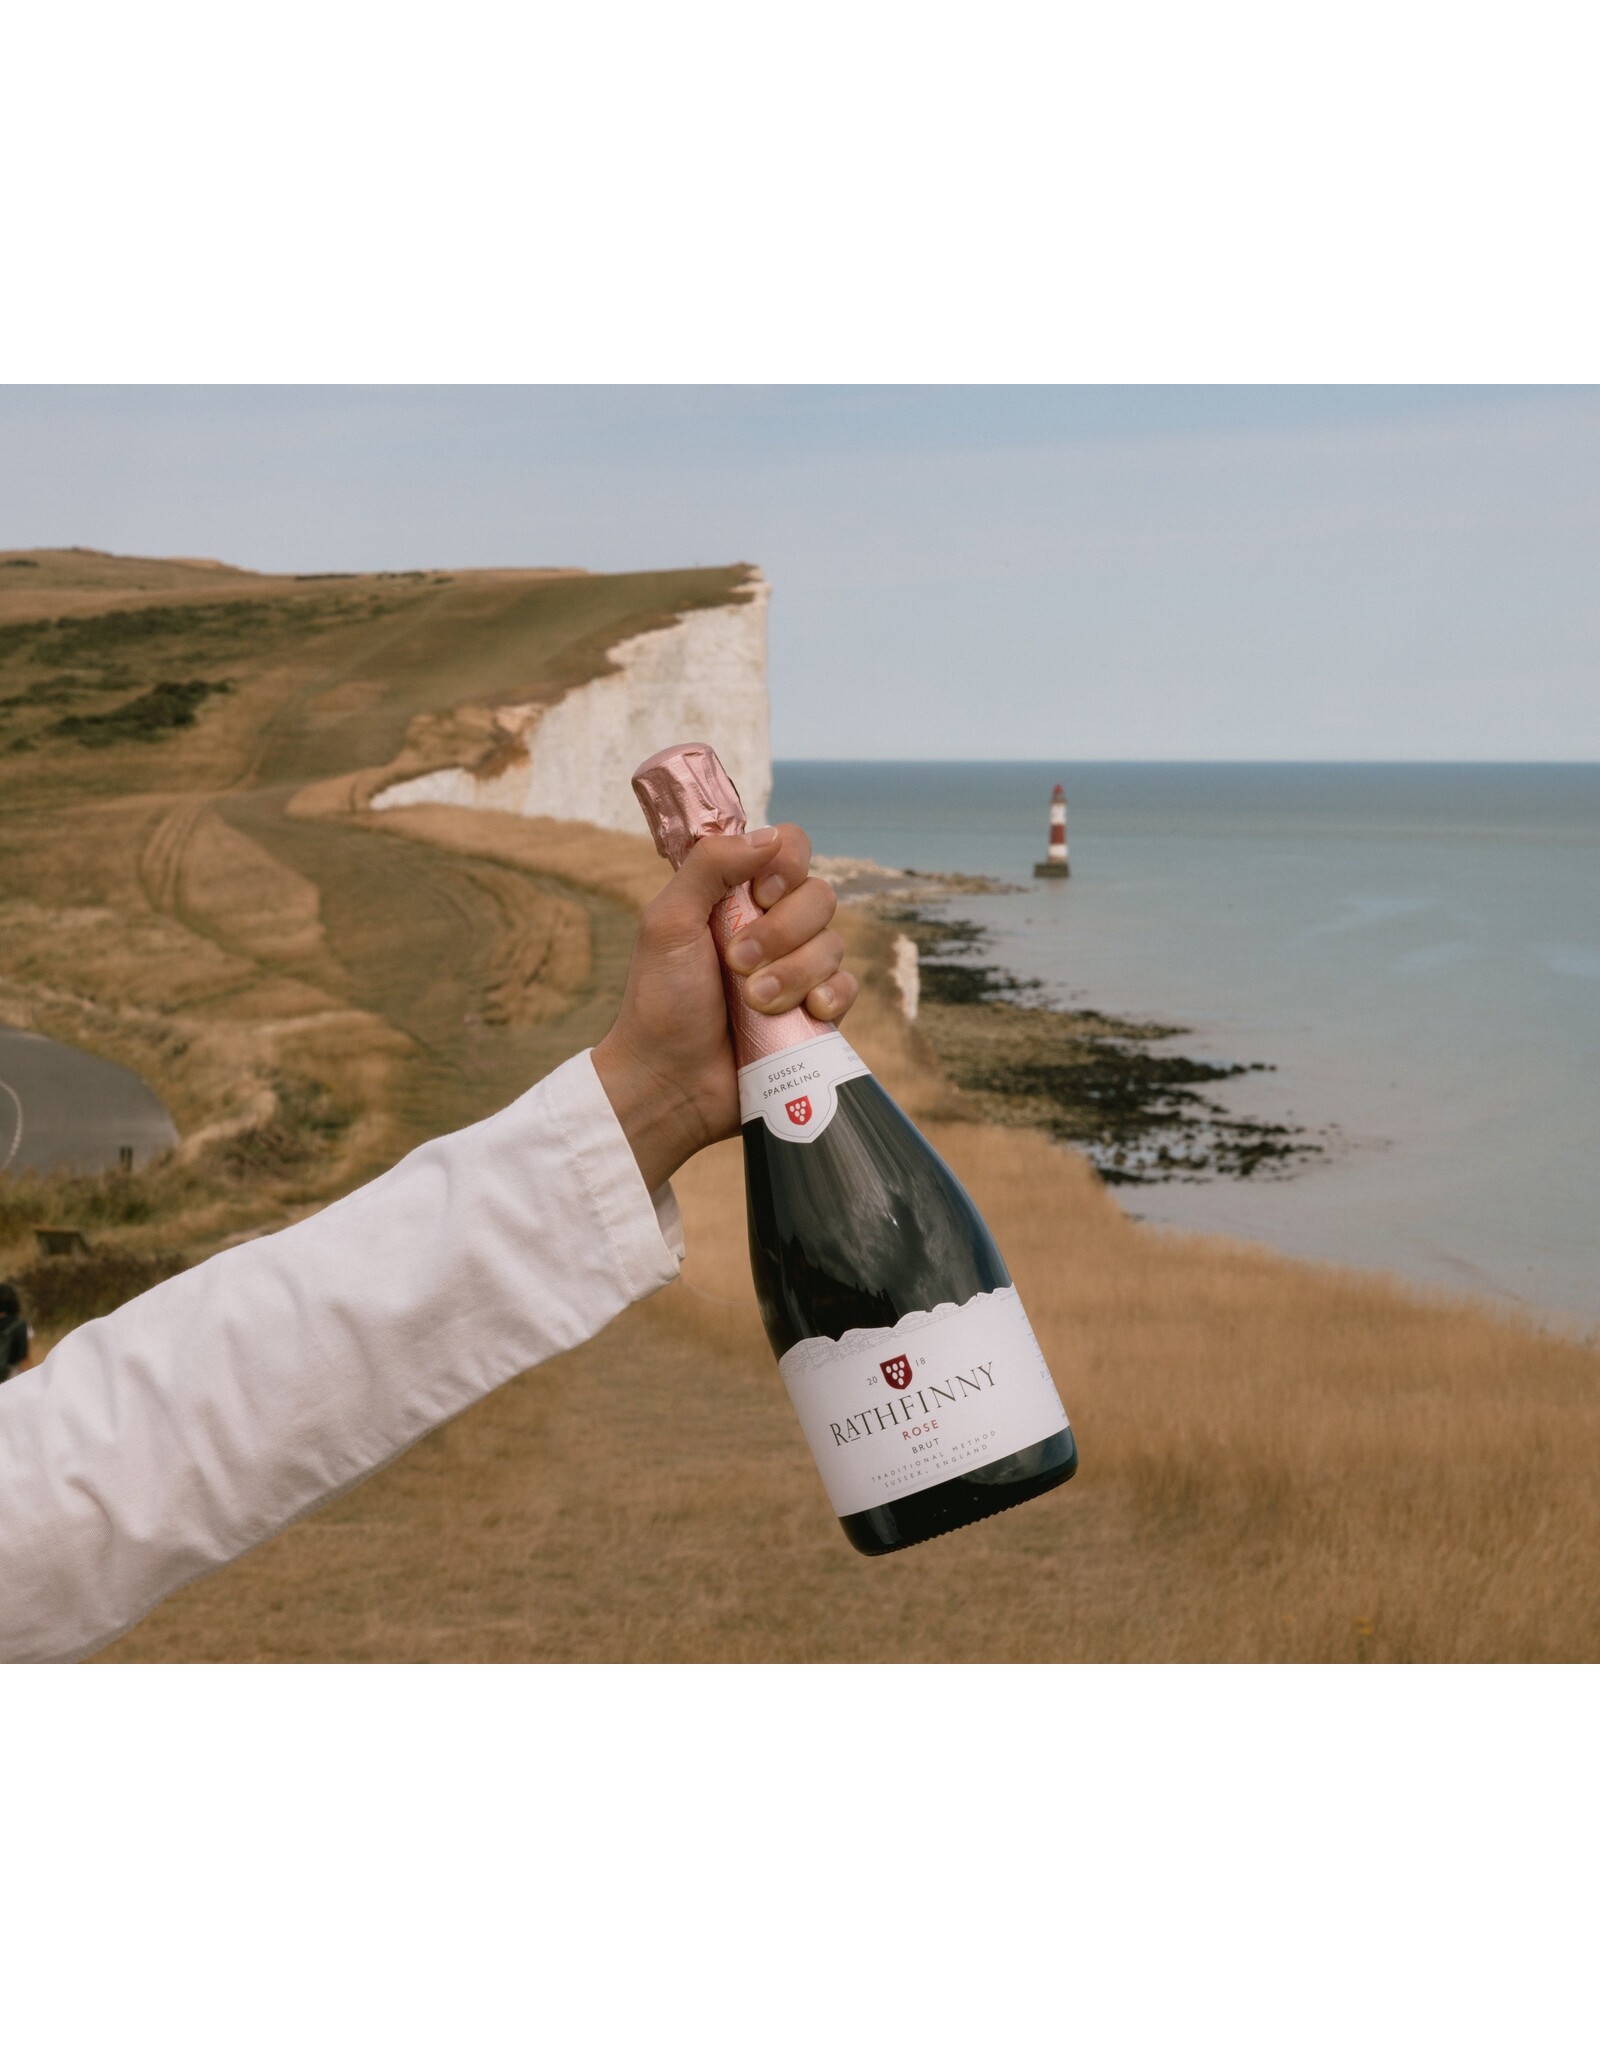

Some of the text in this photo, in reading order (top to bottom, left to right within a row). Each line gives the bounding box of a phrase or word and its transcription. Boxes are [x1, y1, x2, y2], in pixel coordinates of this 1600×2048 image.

[763, 1070, 821, 1099] SPARKLING
[768, 1062, 806, 1083] SUSSEX
[867, 1358, 926, 1386] 20 18
[829, 1361, 996, 1447] RATHFINNY
[902, 1419, 939, 1440] ROSE
[871, 1430, 996, 1482] TRADITIONAL METHOD
[912, 1438, 939, 1454] BRUT
[936, 1444, 987, 1469] ENGLAND
